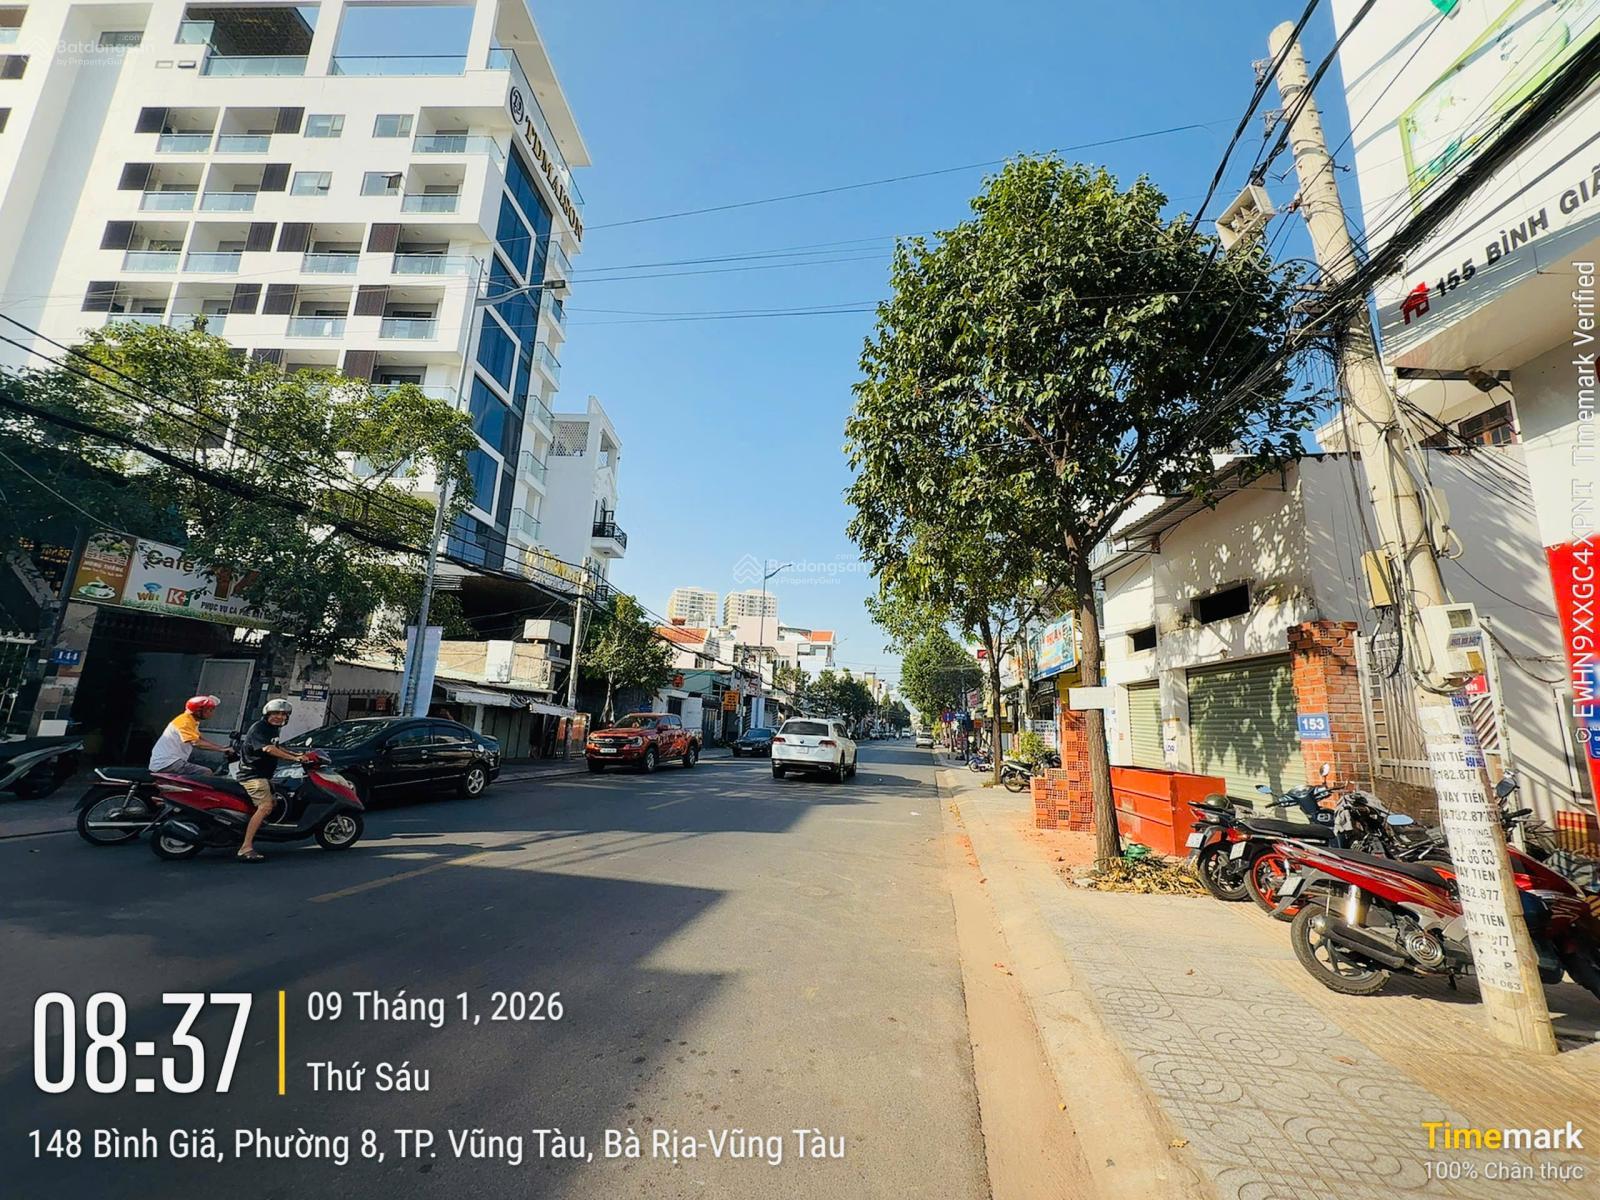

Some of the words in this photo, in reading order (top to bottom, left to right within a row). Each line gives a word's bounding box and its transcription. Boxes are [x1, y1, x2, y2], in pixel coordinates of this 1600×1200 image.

[1436, 258, 1476, 297] 155
[1486, 207, 1549, 266] BÌNH
[168, 590, 190, 604] K+
[1302, 717, 1325, 730] 153
